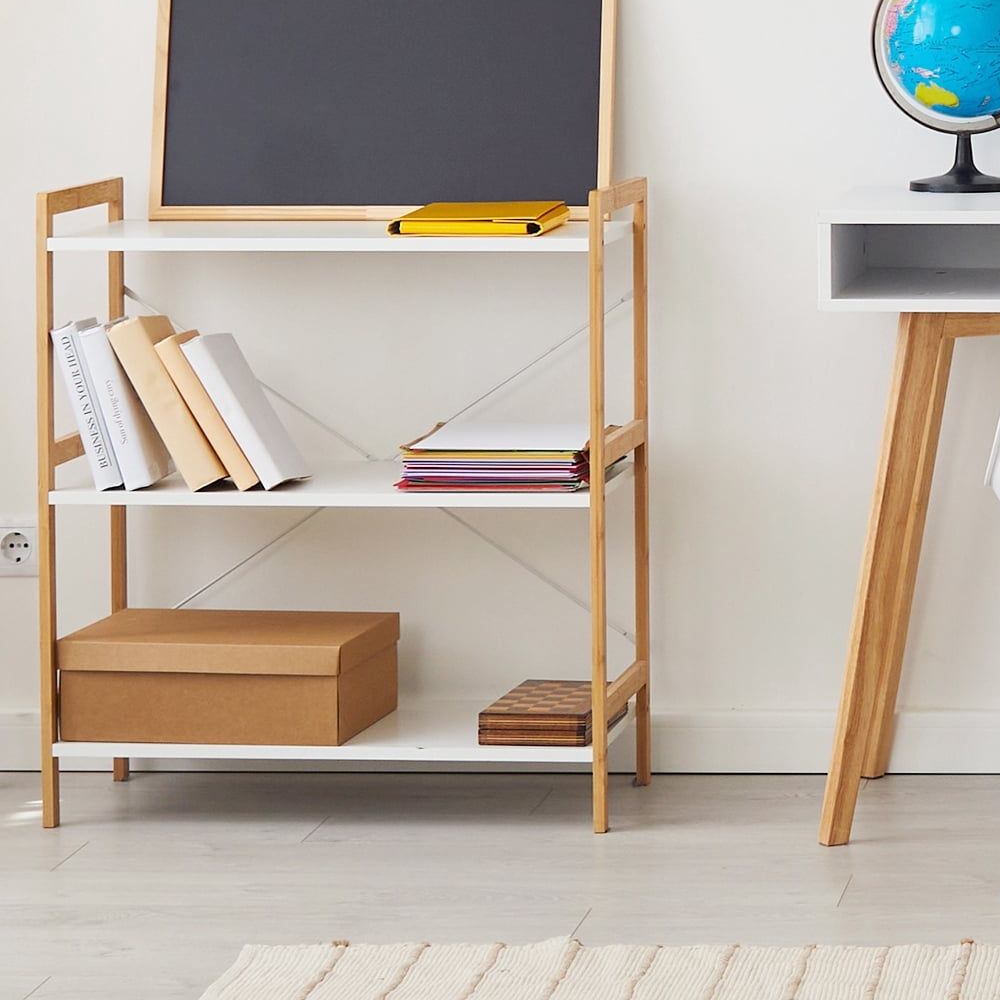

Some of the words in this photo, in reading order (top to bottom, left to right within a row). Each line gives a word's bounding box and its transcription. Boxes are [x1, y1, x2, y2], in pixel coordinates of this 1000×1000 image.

[60, 335, 77, 368] HEAD
[71, 370, 87, 401] YOUR
[81, 402, 93, 415] IN
[86, 416, 109, 469] BUSINESS
